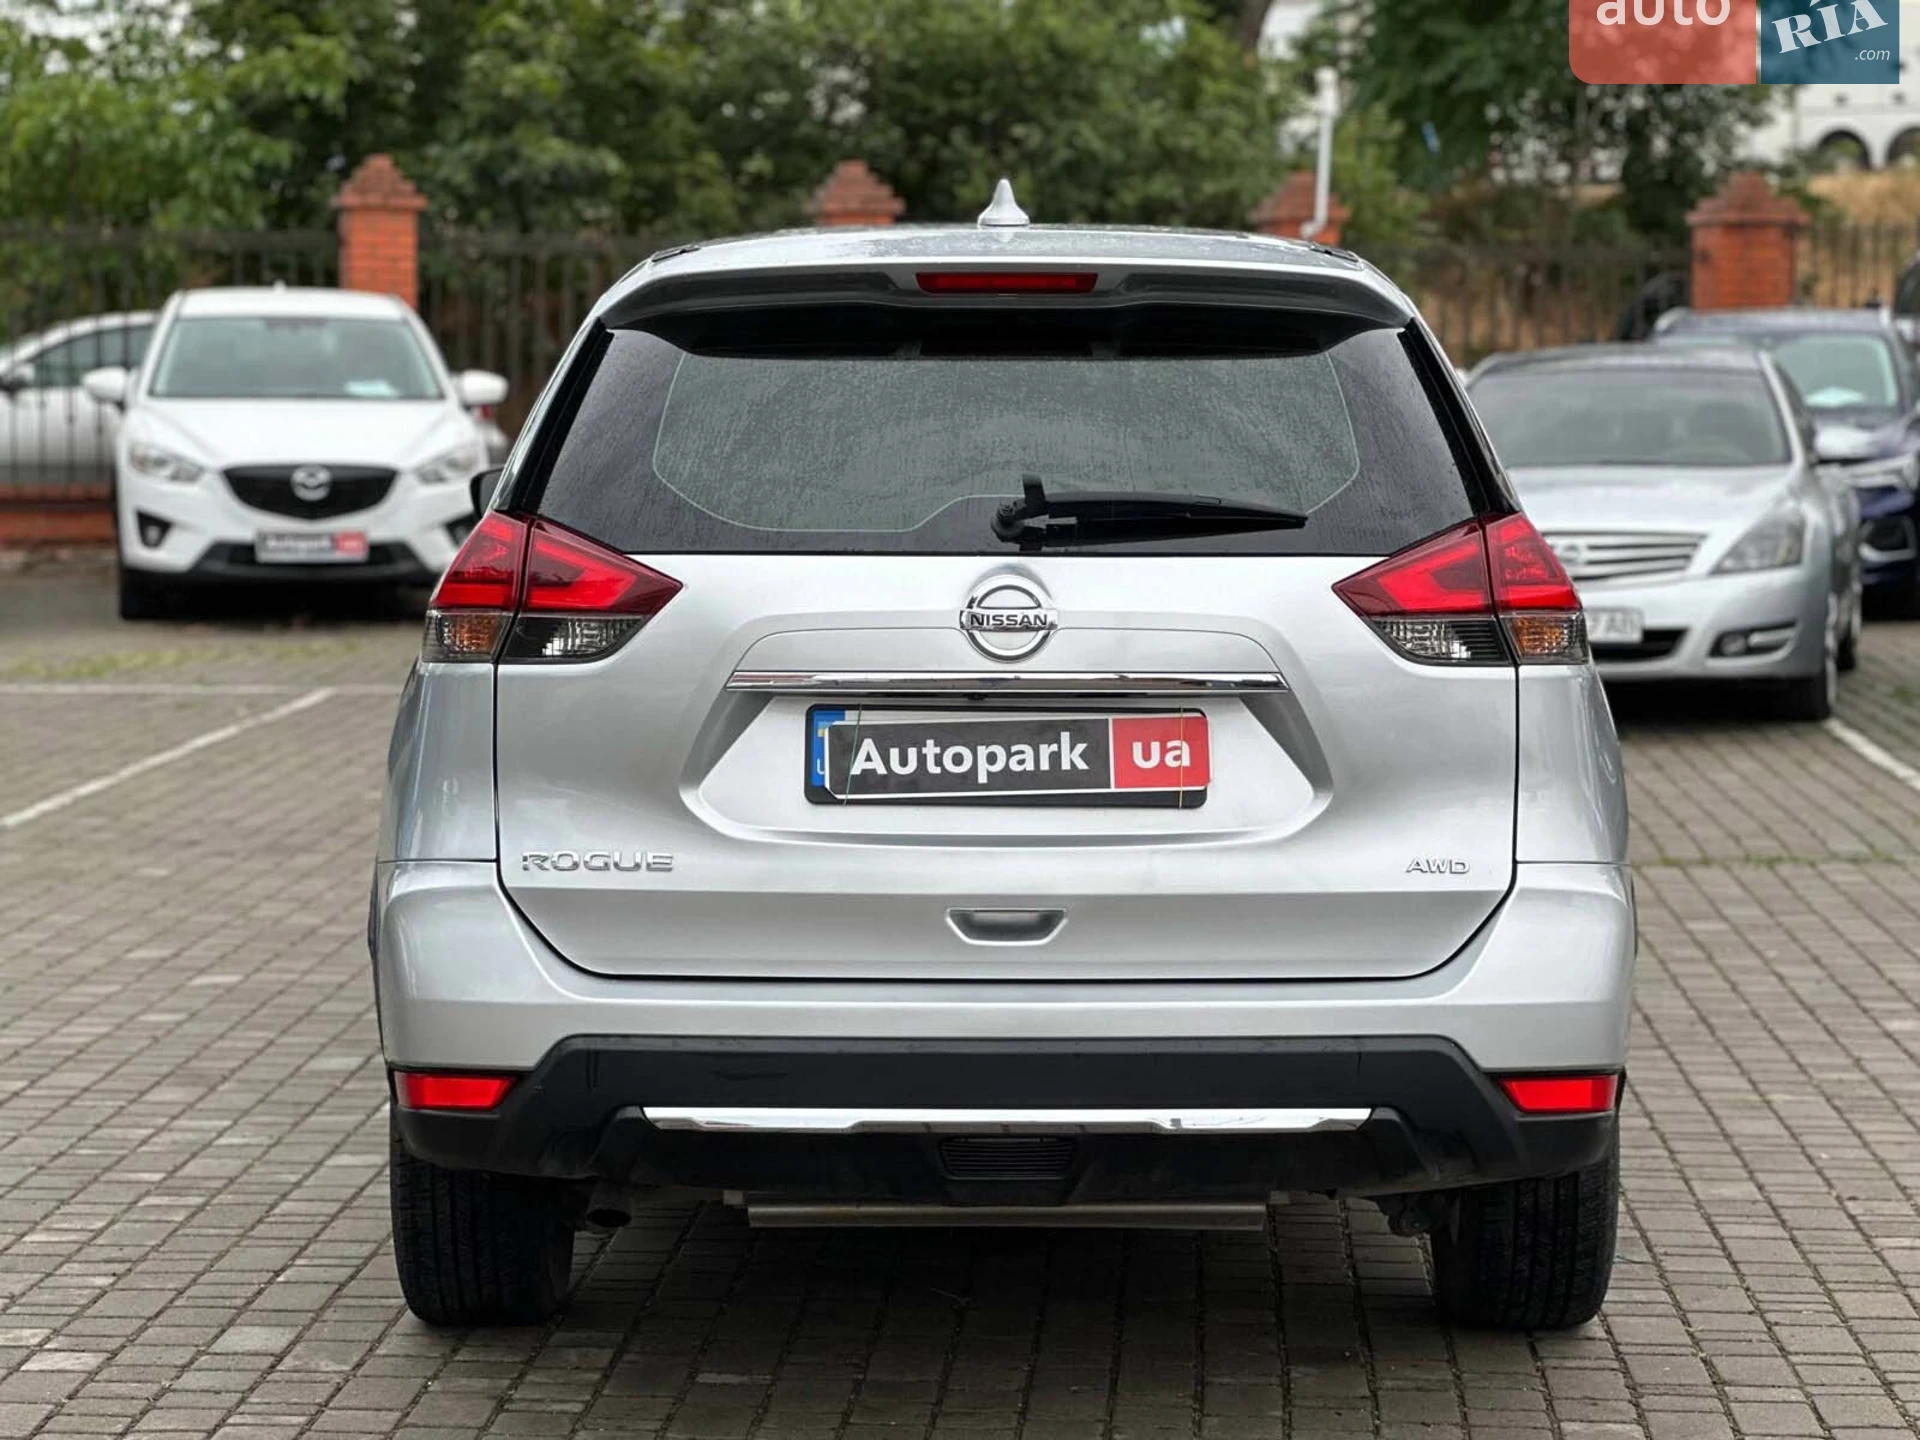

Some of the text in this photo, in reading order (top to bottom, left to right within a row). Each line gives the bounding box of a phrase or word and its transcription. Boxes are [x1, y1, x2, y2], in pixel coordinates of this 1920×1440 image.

[970, 613, 1048, 627] NISSAN
[850, 731, 1191, 784] Autopark ua
[521, 850, 674, 873] ROGUE
[1405, 856, 1470, 875] AWD
